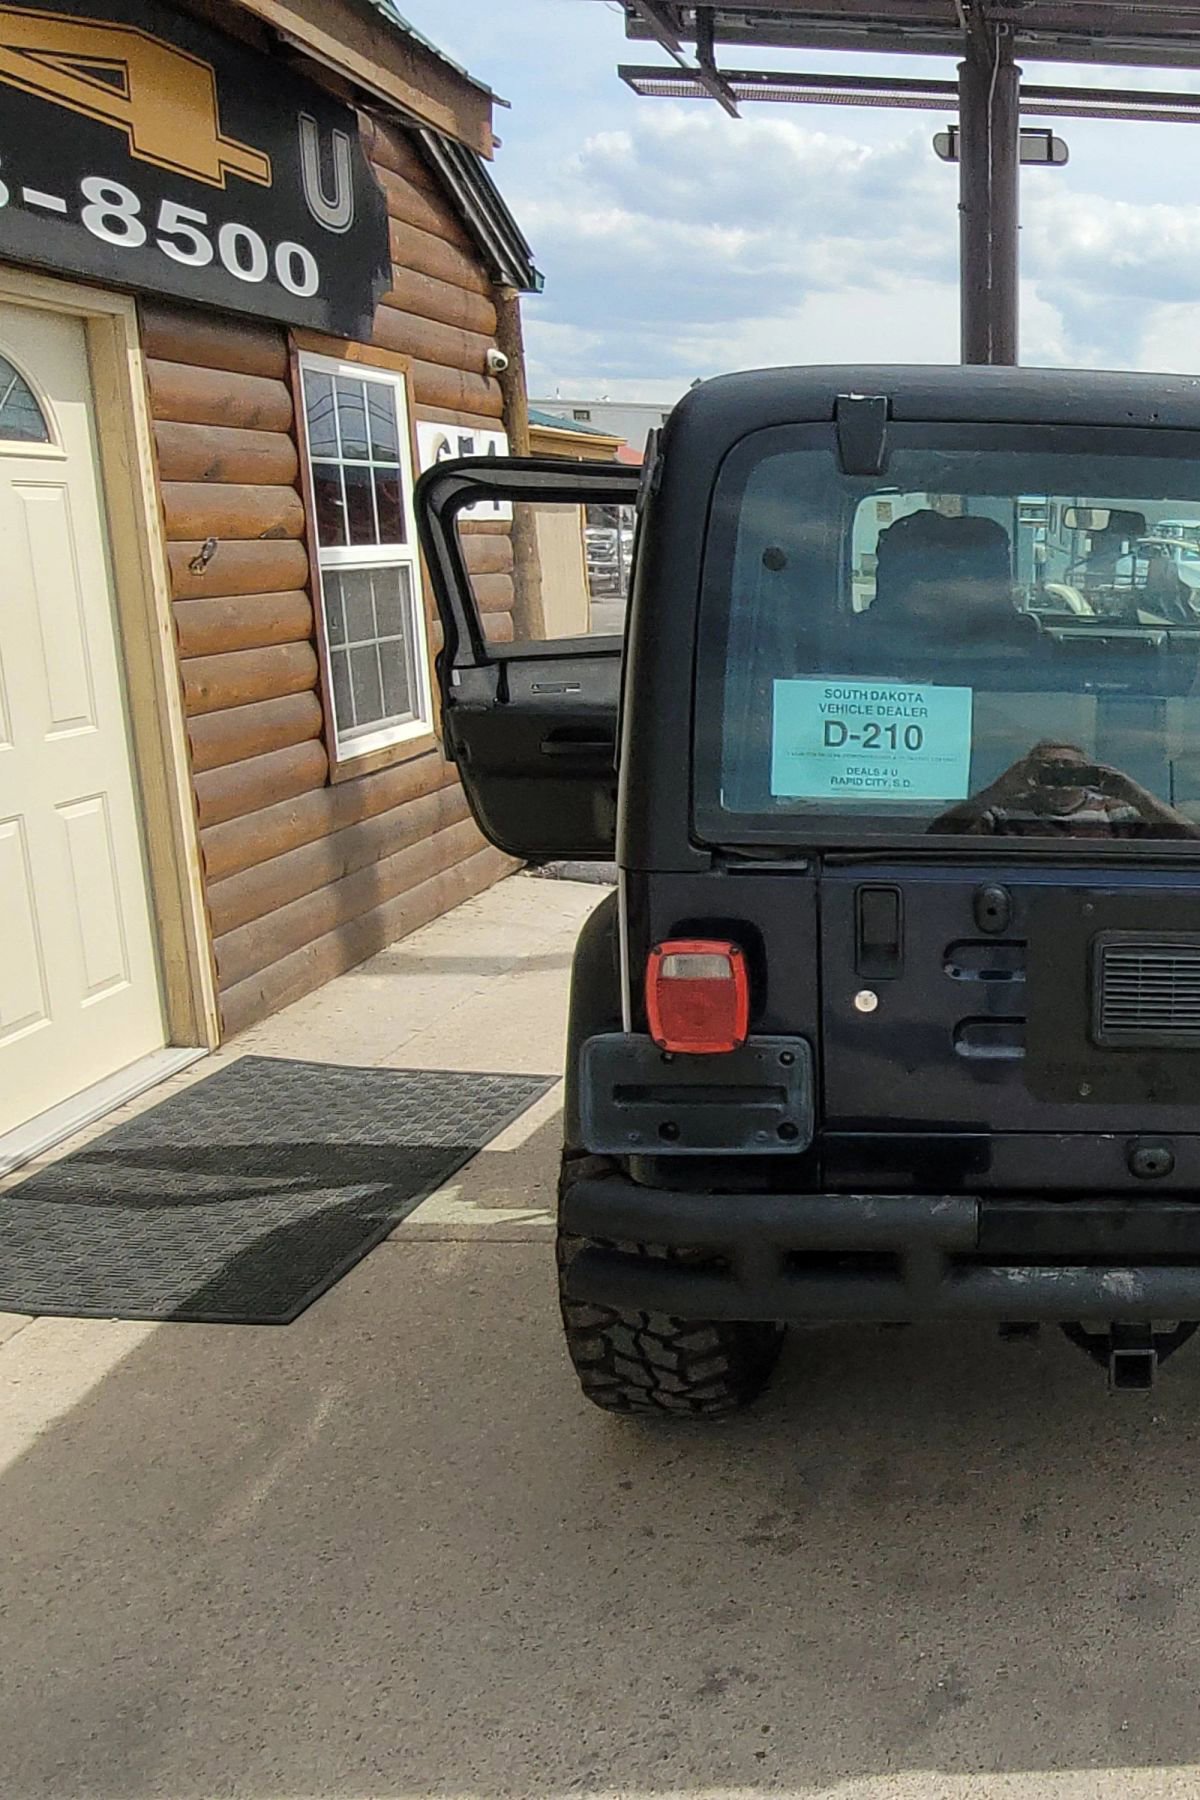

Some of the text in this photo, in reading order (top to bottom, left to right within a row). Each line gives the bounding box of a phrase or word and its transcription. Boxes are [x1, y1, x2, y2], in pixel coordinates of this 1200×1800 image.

[299, 110, 354, 234] U
[0, 158, 320, 297] -8500
[824, 688, 923, 703] SOUTH DAKOTA
[819, 703, 928, 718] VEHICLE DEALER
[823, 719, 923, 751] D-210
[846, 767, 880, 777] DEALS
[830, 776, 864, 786] RAPID
